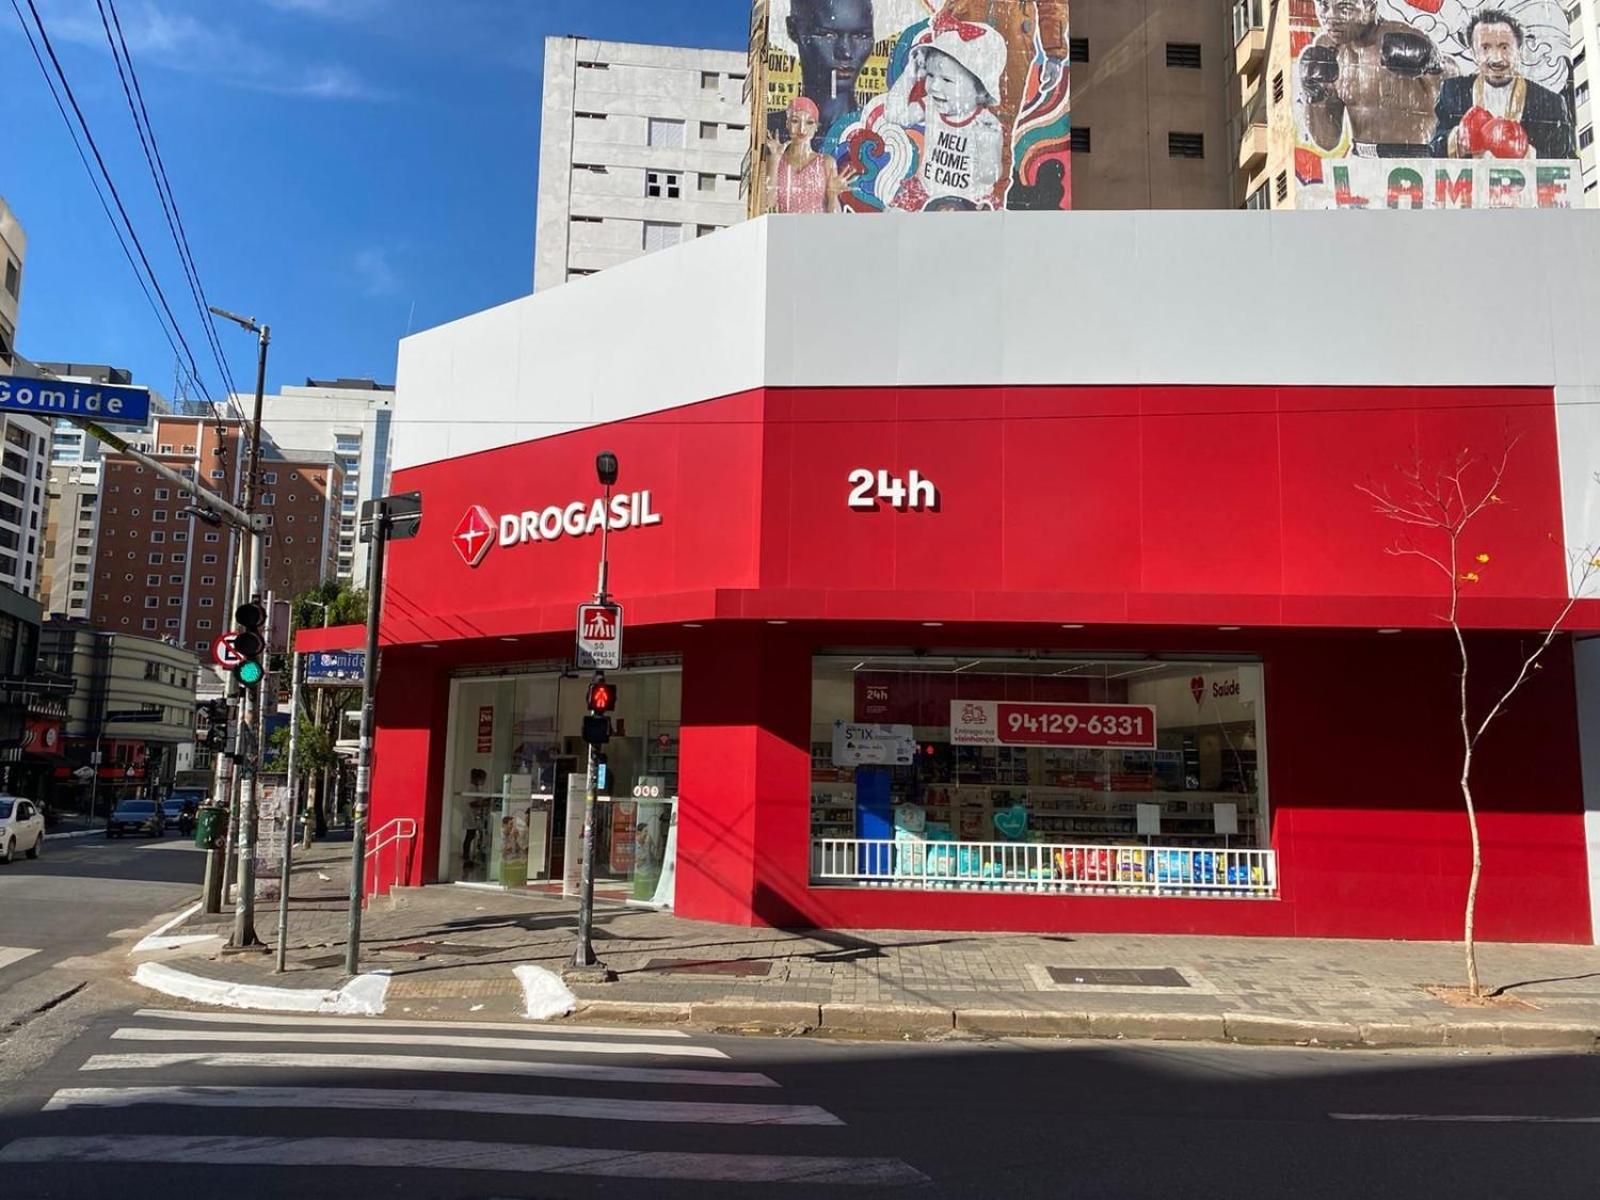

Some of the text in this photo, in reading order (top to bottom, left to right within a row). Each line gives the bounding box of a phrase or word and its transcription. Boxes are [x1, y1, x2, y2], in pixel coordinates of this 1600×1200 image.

[768, 54, 796, 72] ONEY
[860, 67, 888, 77] UST
[768, 82, 794, 93] UST
[937, 131, 967, 153] MEU
[931, 148, 970, 170] NOME
[934, 167, 970, 189] CAOS
[0, 381, 123, 413] Gomide
[848, 469, 934, 507] 24h
[500, 490, 661, 546] DROGASIL
[866, 690, 888, 700] 24h
[1212, 679, 1240, 698] Saúde
[1008, 713, 1143, 735] 94129-6331
